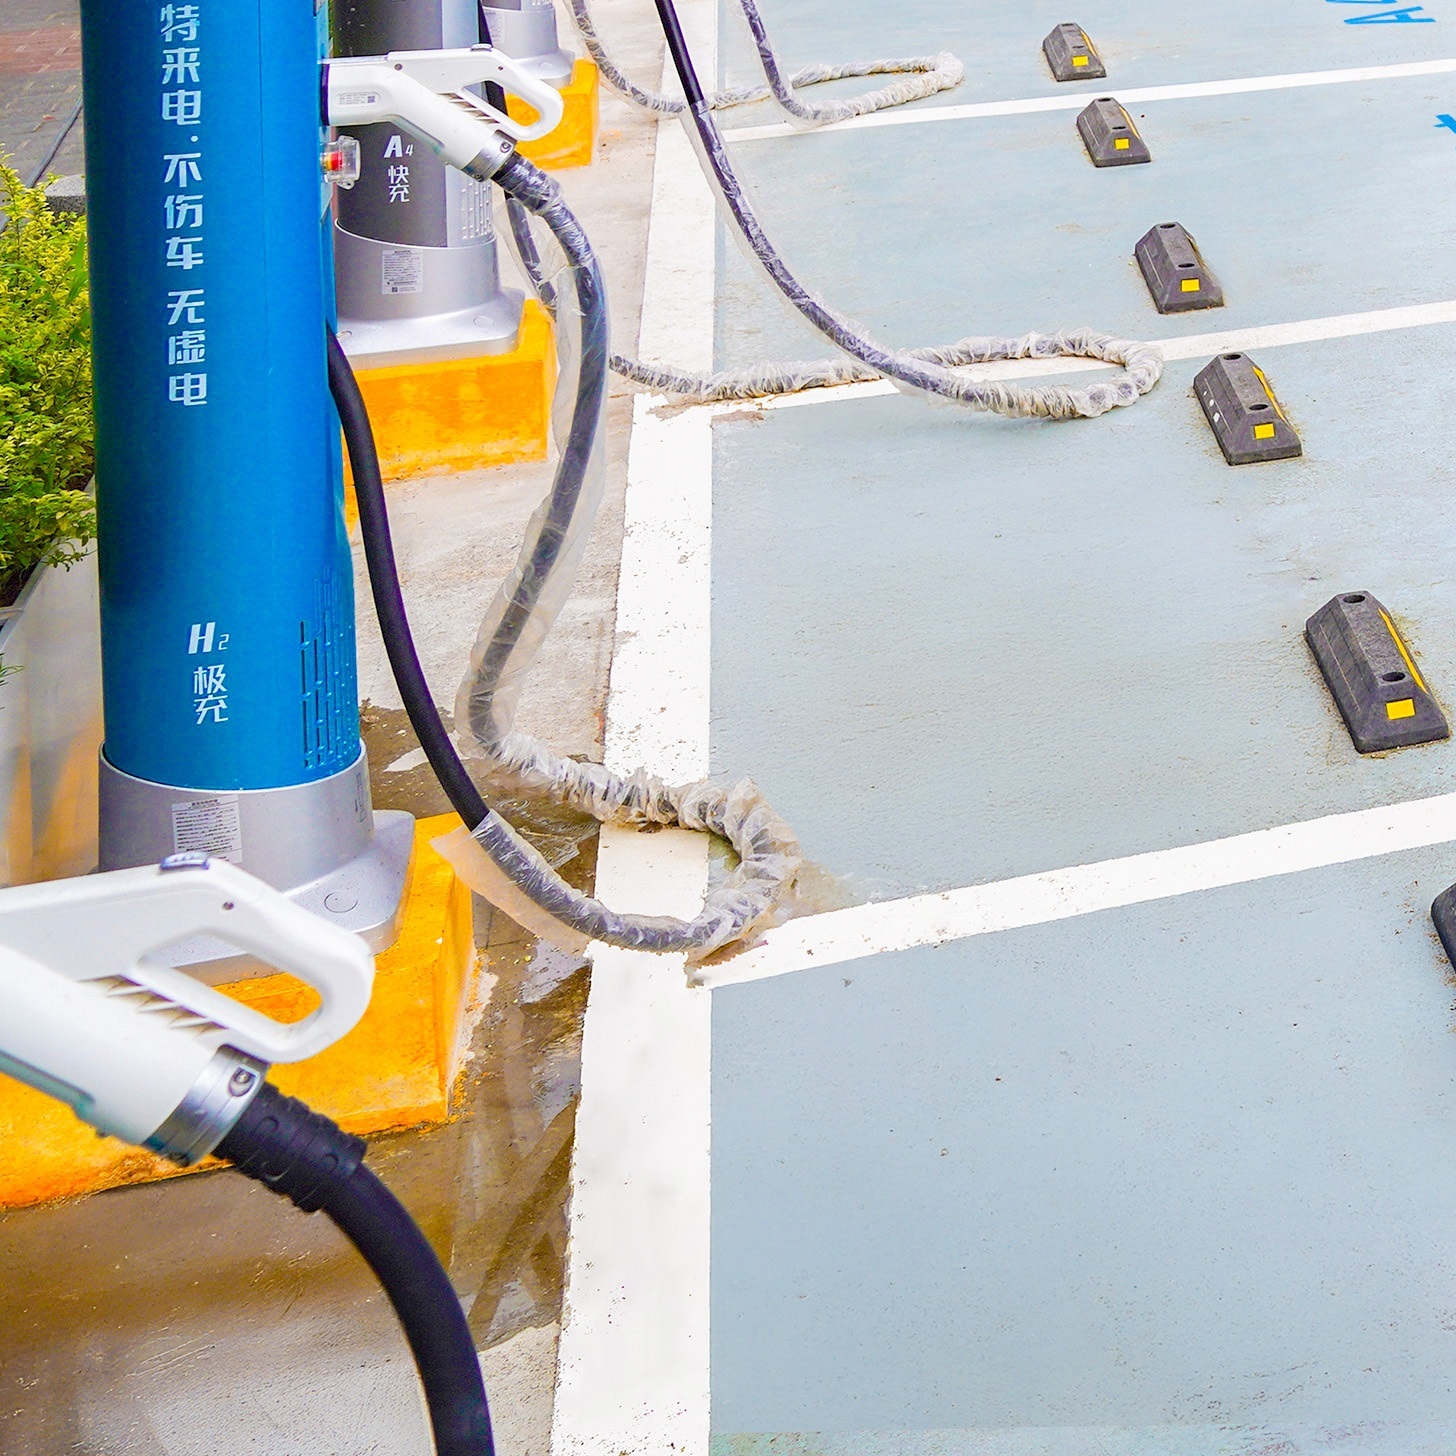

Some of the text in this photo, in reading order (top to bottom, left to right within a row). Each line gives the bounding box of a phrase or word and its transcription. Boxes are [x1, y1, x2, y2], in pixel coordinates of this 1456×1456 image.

[384, 135, 414, 159] A4
[388, 164, 410, 204] 快充
[166, 289, 209, 407] 无虚电
[188, 621, 230, 656] H2
[193, 663, 229, 725] 极充
